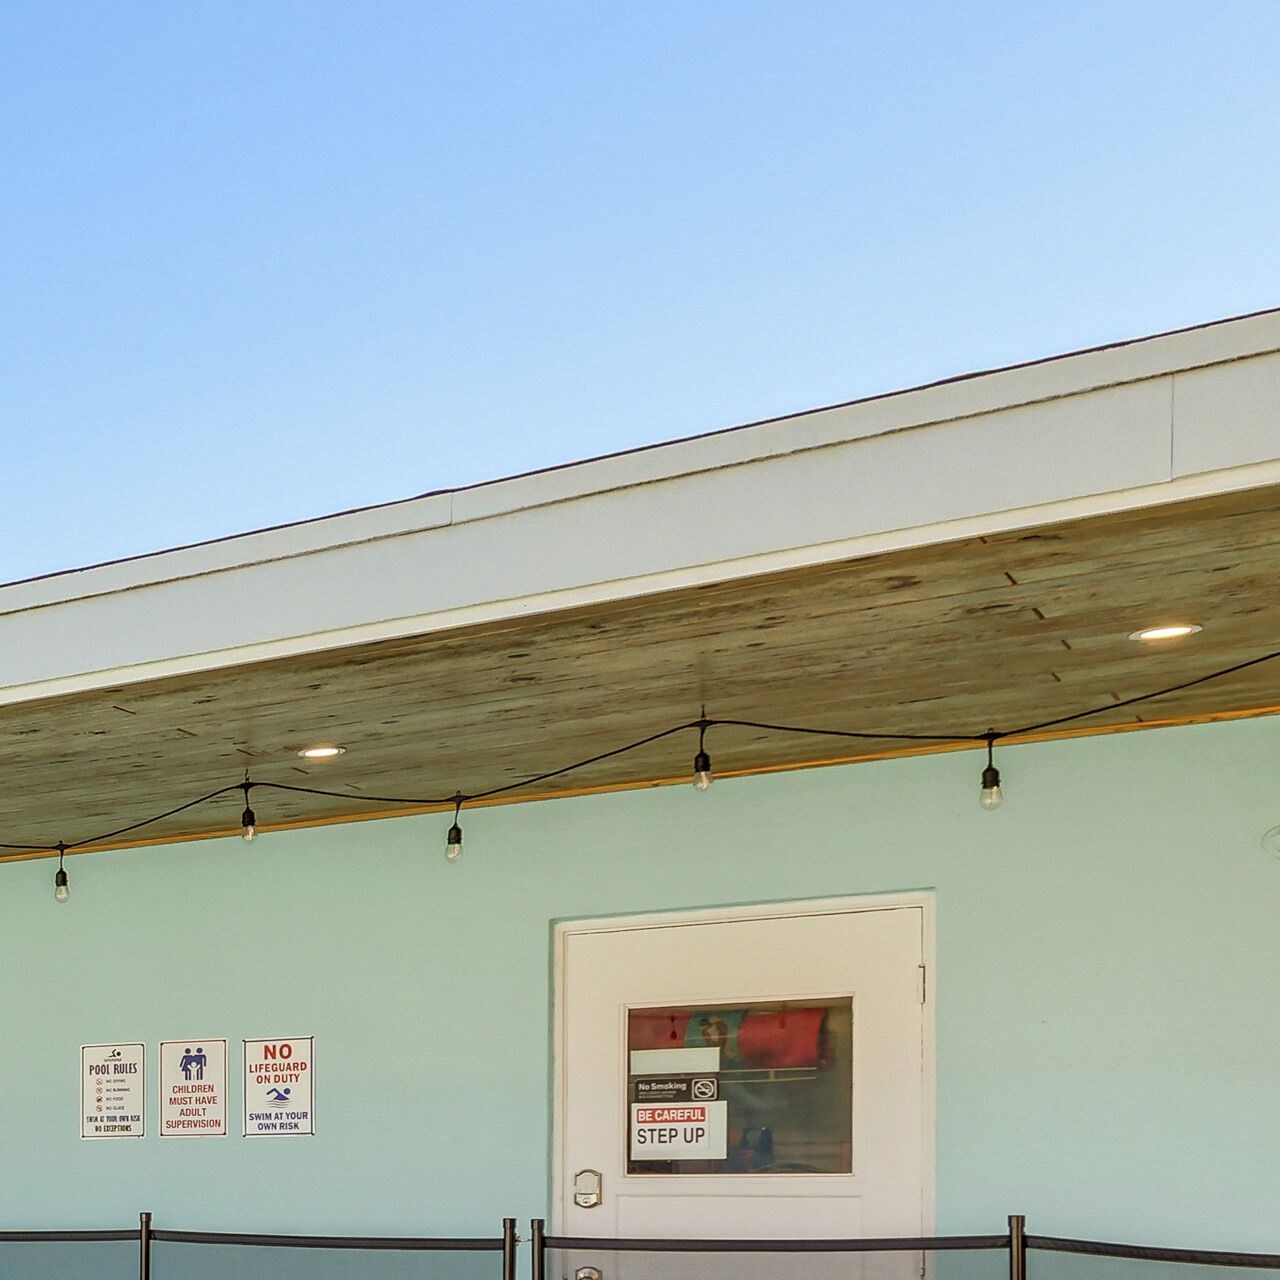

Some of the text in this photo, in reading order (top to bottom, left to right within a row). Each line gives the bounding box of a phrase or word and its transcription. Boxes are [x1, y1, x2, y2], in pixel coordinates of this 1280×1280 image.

[264, 1043, 292, 1060] NO
[89, 1063, 138, 1075] POOL RULES
[249, 1062, 307, 1073] LIFEGUARD
[256, 1074, 300, 1084] ON DUTY
[172, 1084, 214, 1094] CHILDREN
[638, 1082, 687, 1091] No Smoking
[169, 1096, 218, 1105] MUST HAVE
[179, 1108, 207, 1117] ADULT
[249, 1111, 308, 1121] SWIM AT YOUR
[638, 1109, 704, 1121] BE CAREFUL
[165, 1119, 221, 1129] SUPERVISION
[257, 1122, 300, 1131] OWN RISK
[637, 1127, 705, 1144] STEP UP
